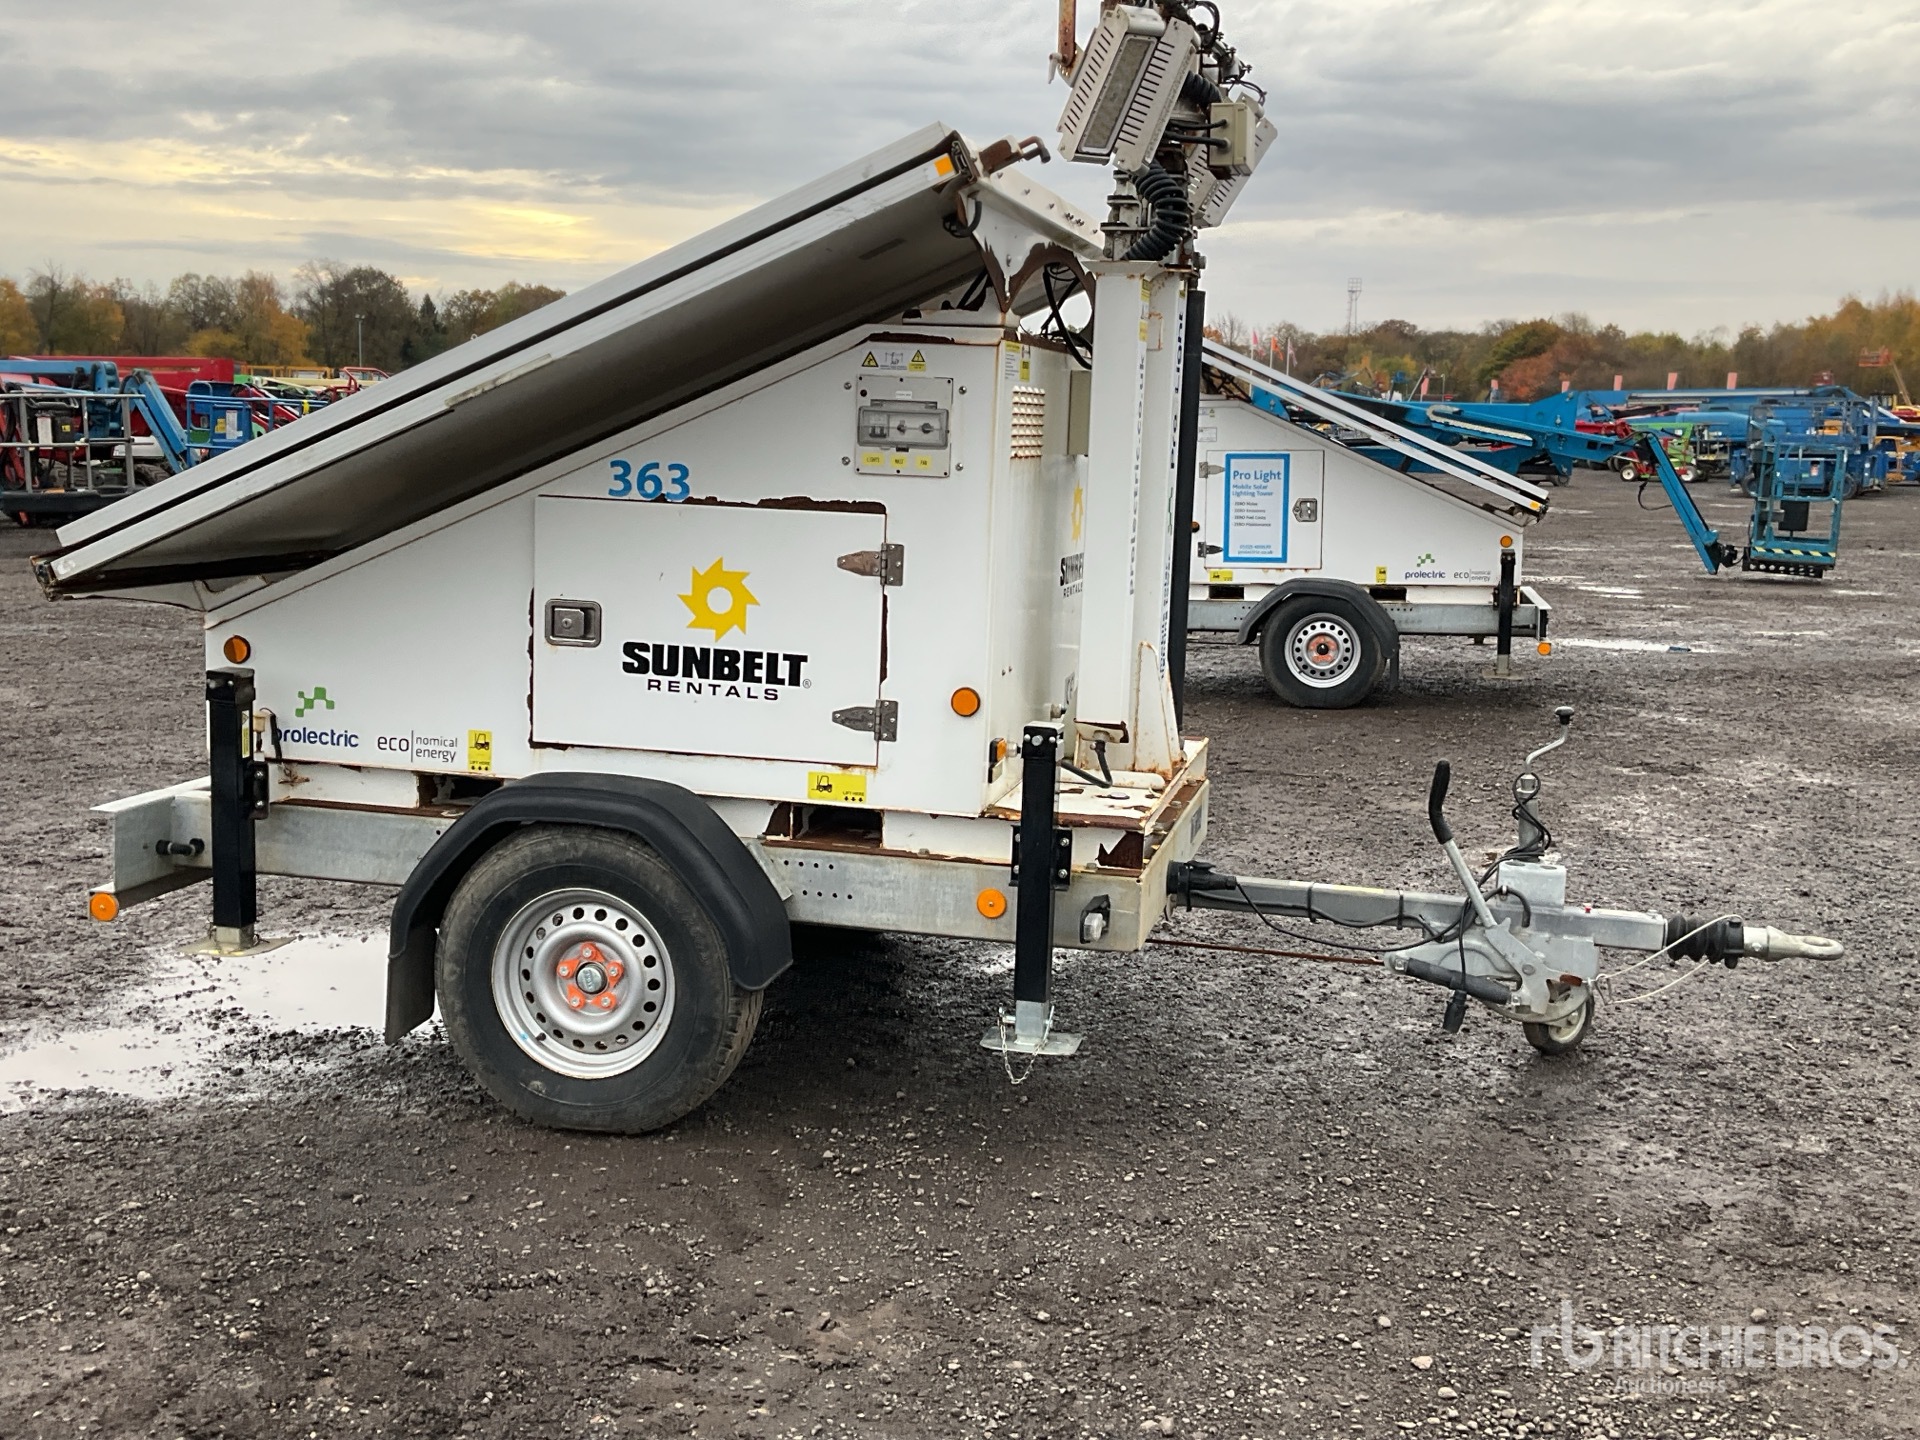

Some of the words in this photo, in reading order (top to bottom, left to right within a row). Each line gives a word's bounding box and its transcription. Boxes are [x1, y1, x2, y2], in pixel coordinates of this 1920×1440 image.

[608, 459, 691, 502] 363
[1233, 470, 1251, 480] Pro
[1254, 469, 1282, 483] Light
[1404, 570, 1446, 580] prolectric
[1453, 571, 1470, 579] eco
[622, 641, 808, 687] SUNBELT
[647, 678, 779, 701] RENTALS
[377, 735, 410, 752] eco
[415, 735, 458, 748] nomical
[415, 747, 457, 763] energy
